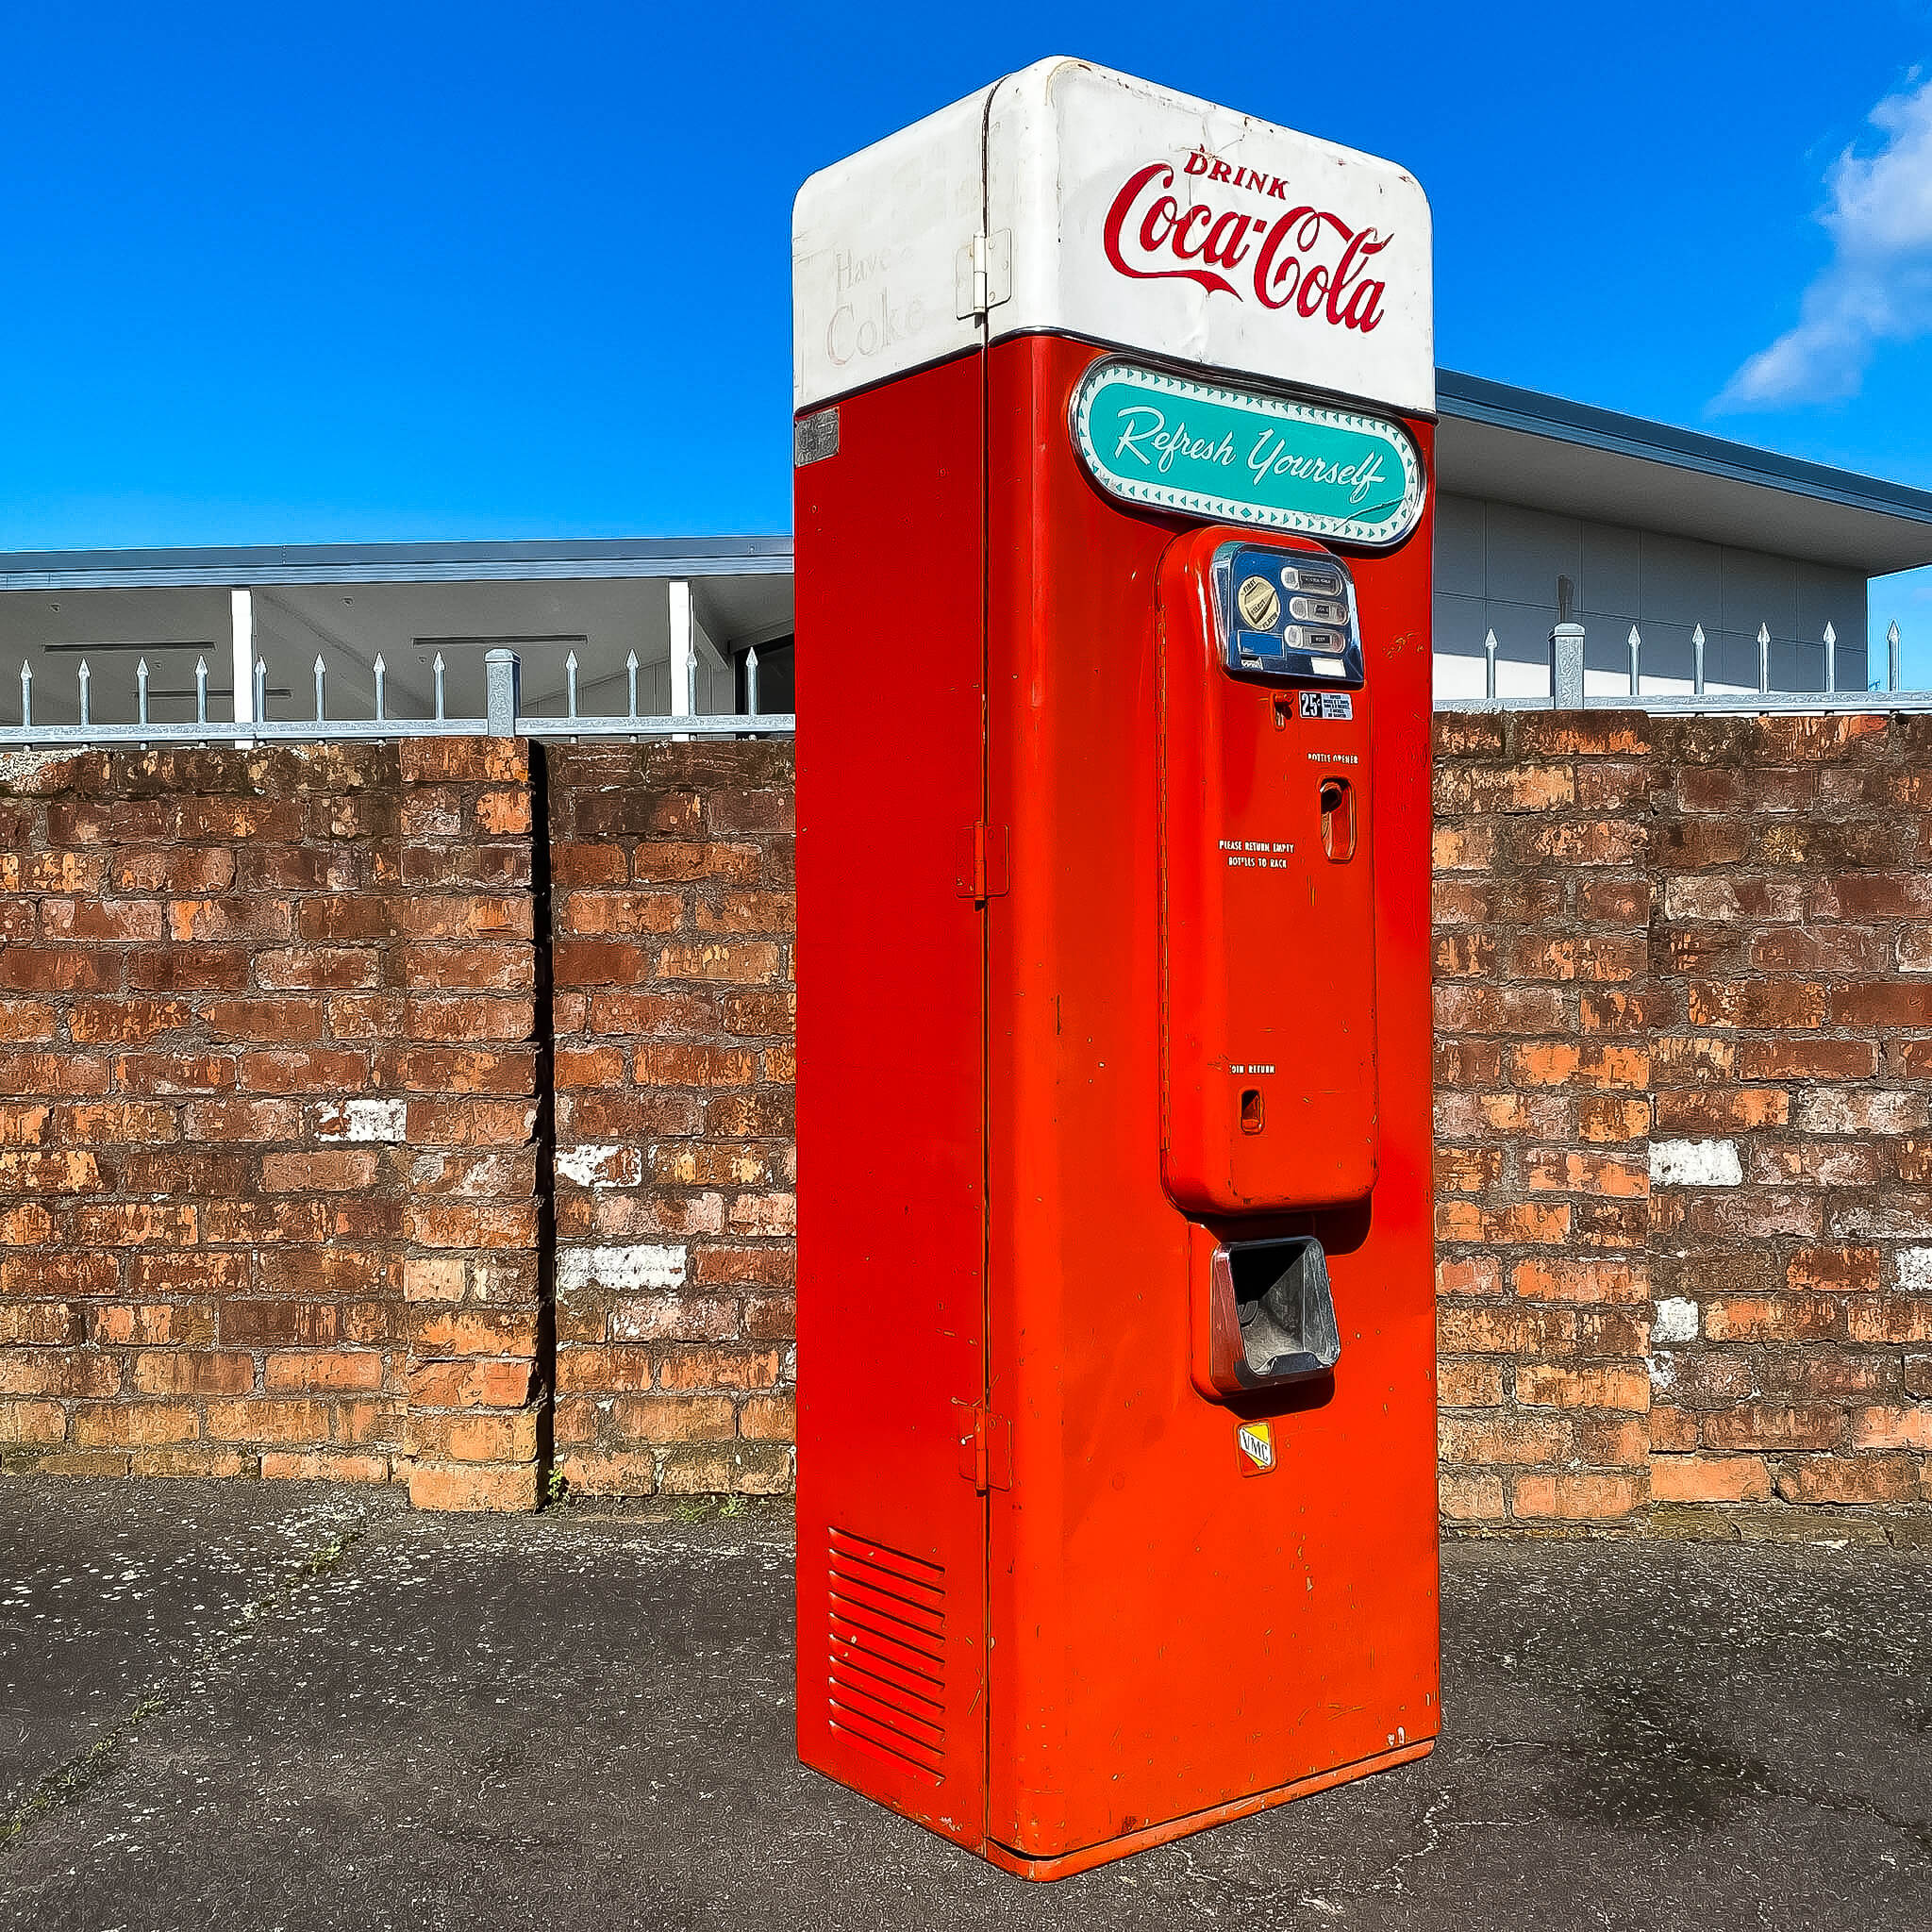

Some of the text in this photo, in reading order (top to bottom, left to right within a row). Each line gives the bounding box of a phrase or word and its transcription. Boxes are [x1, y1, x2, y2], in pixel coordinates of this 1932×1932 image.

[1184, 150, 1290, 201] DRINK
[1103, 162, 1395, 333] Coca-Cola
[1114, 406, 1386, 504] Refresh Yourself
[1242, 577, 1257, 593] FIRST
[1307, 753, 1358, 764] BOTTLE OPENER
[1219, 840, 1294, 854] PLEASE RETURN EMPTY
[1228, 856, 1287, 869] BOTTLES TO RACK
[1248, 1064, 1275, 1074] RETURN
[1241, 1430, 1269, 1462] VMC
